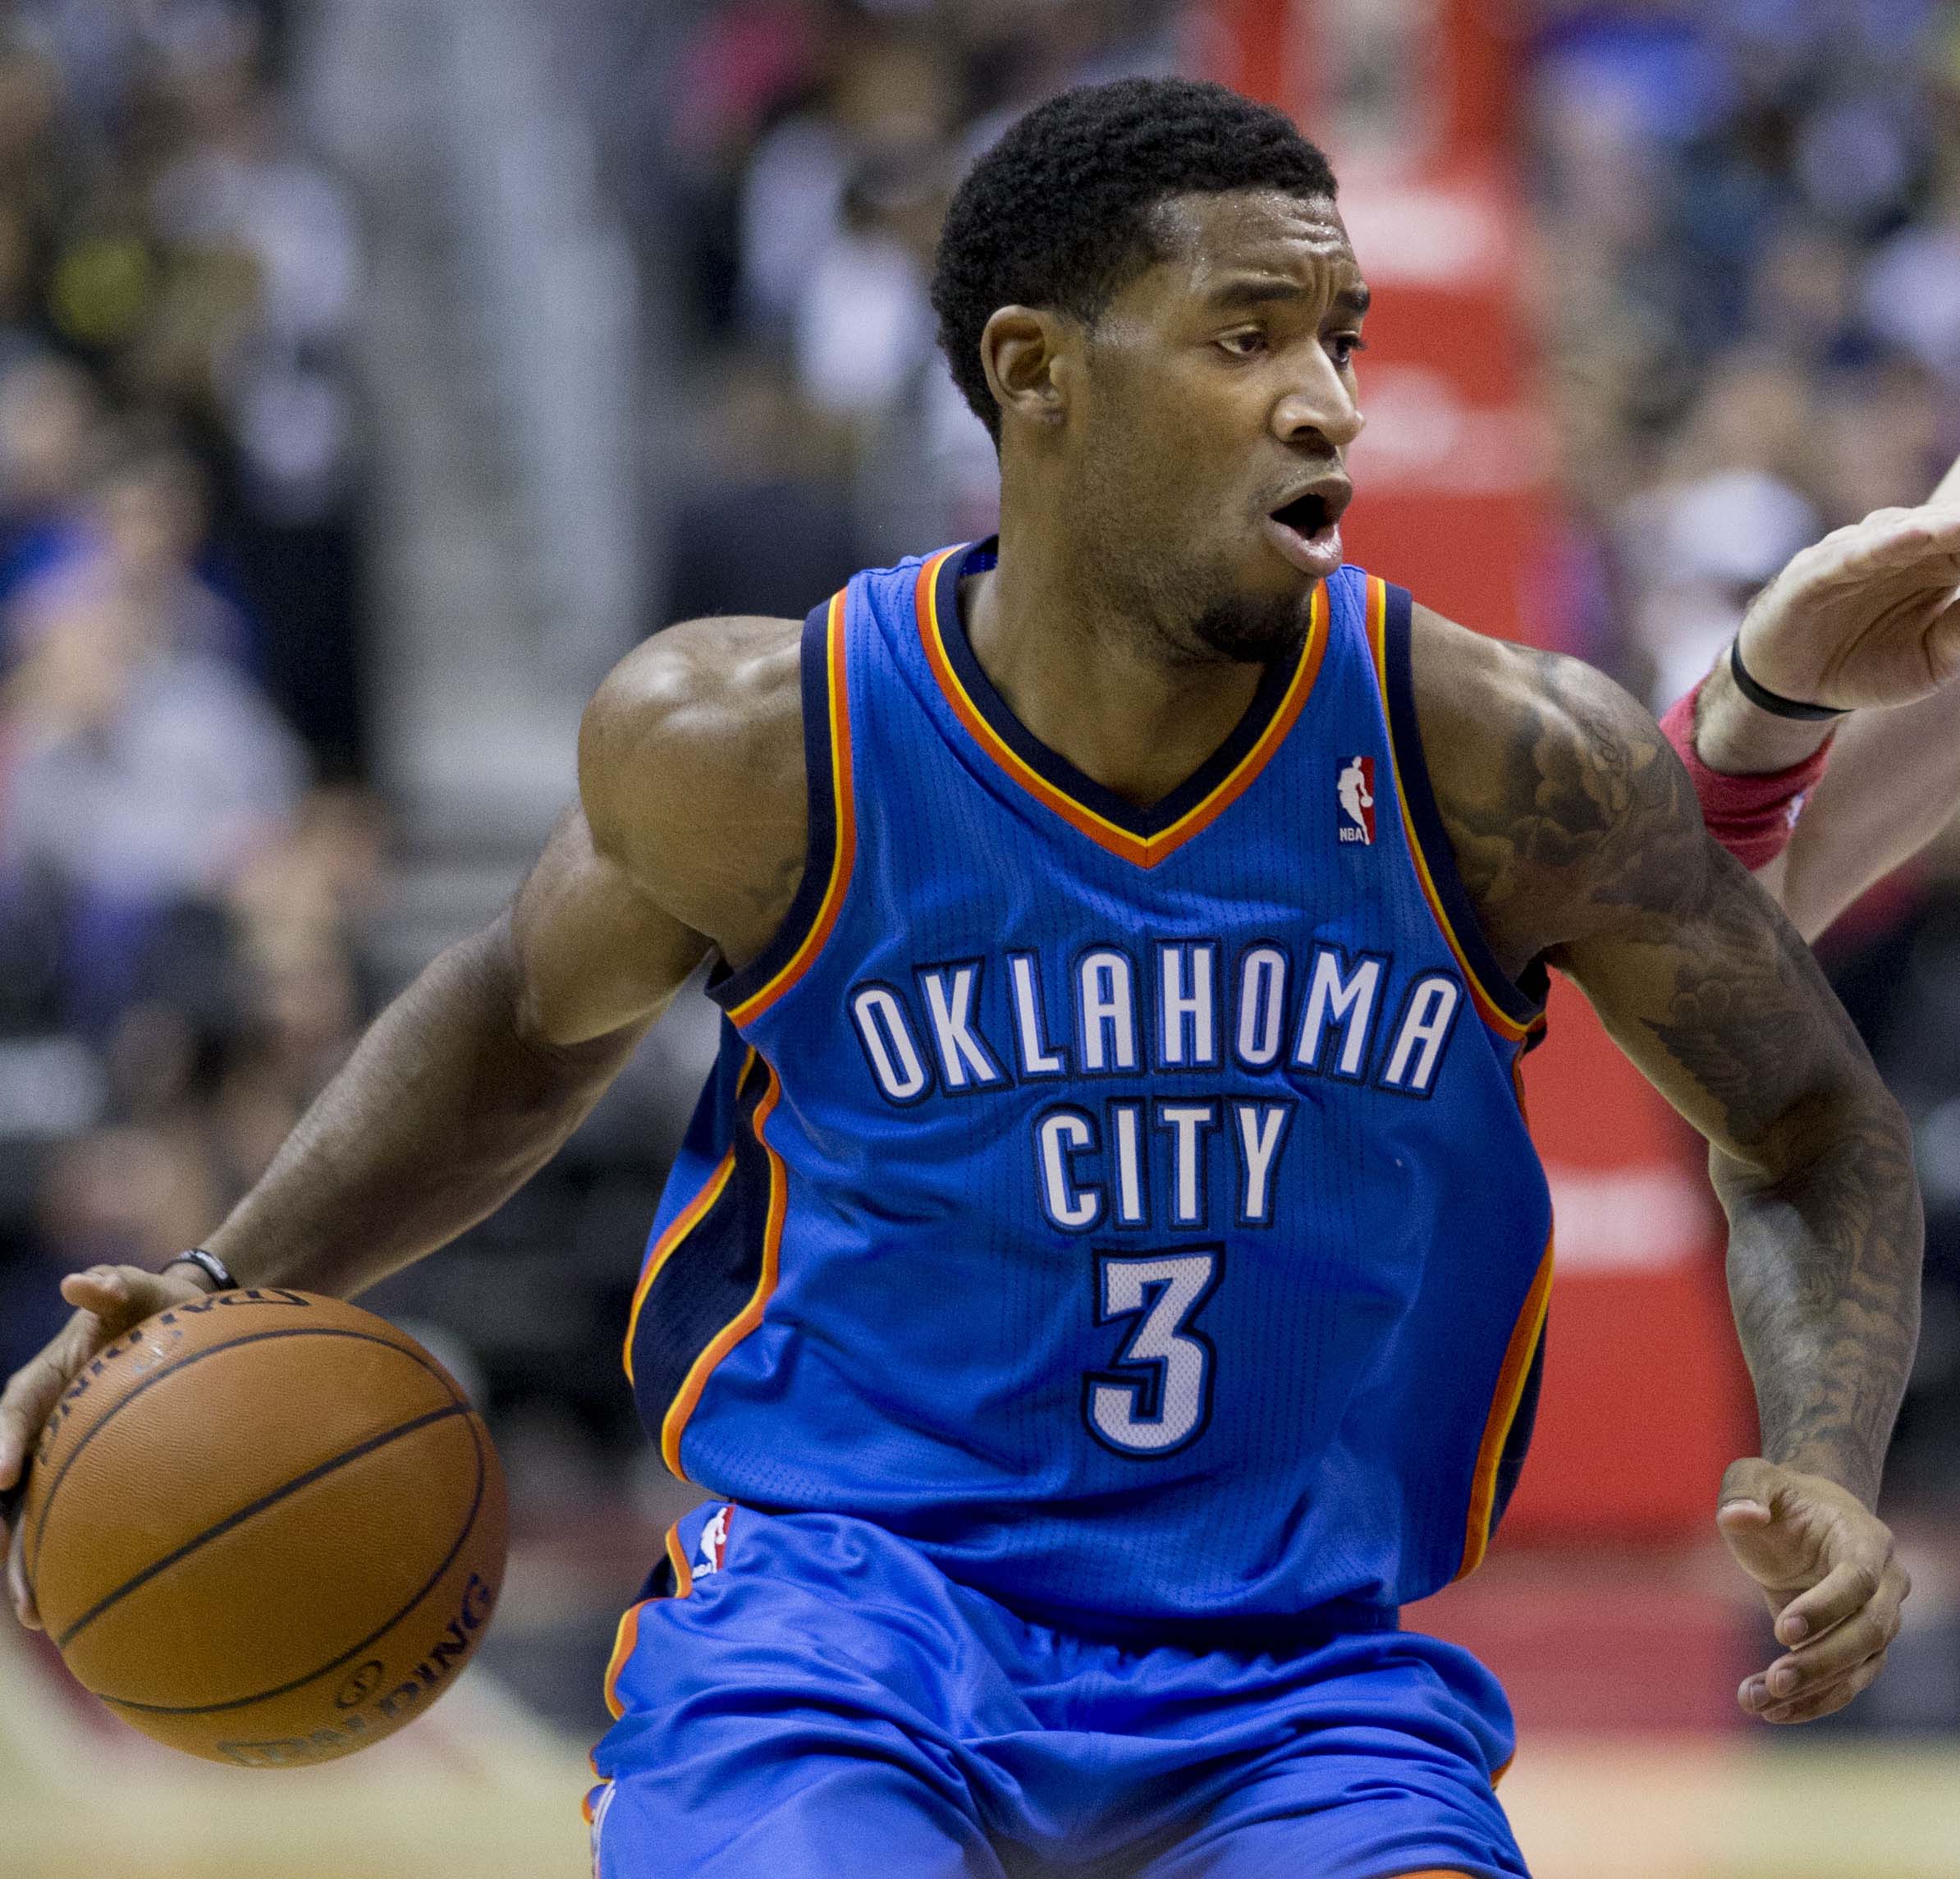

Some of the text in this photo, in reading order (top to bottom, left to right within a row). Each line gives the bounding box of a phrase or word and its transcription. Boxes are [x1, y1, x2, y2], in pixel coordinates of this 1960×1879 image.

[1339, 827, 1363, 842] NBA
[849, 940, 1466, 1107] OKLAHOMA
[1034, 1098, 1295, 1231] CITY
[1083, 1244, 1223, 1460] 3
